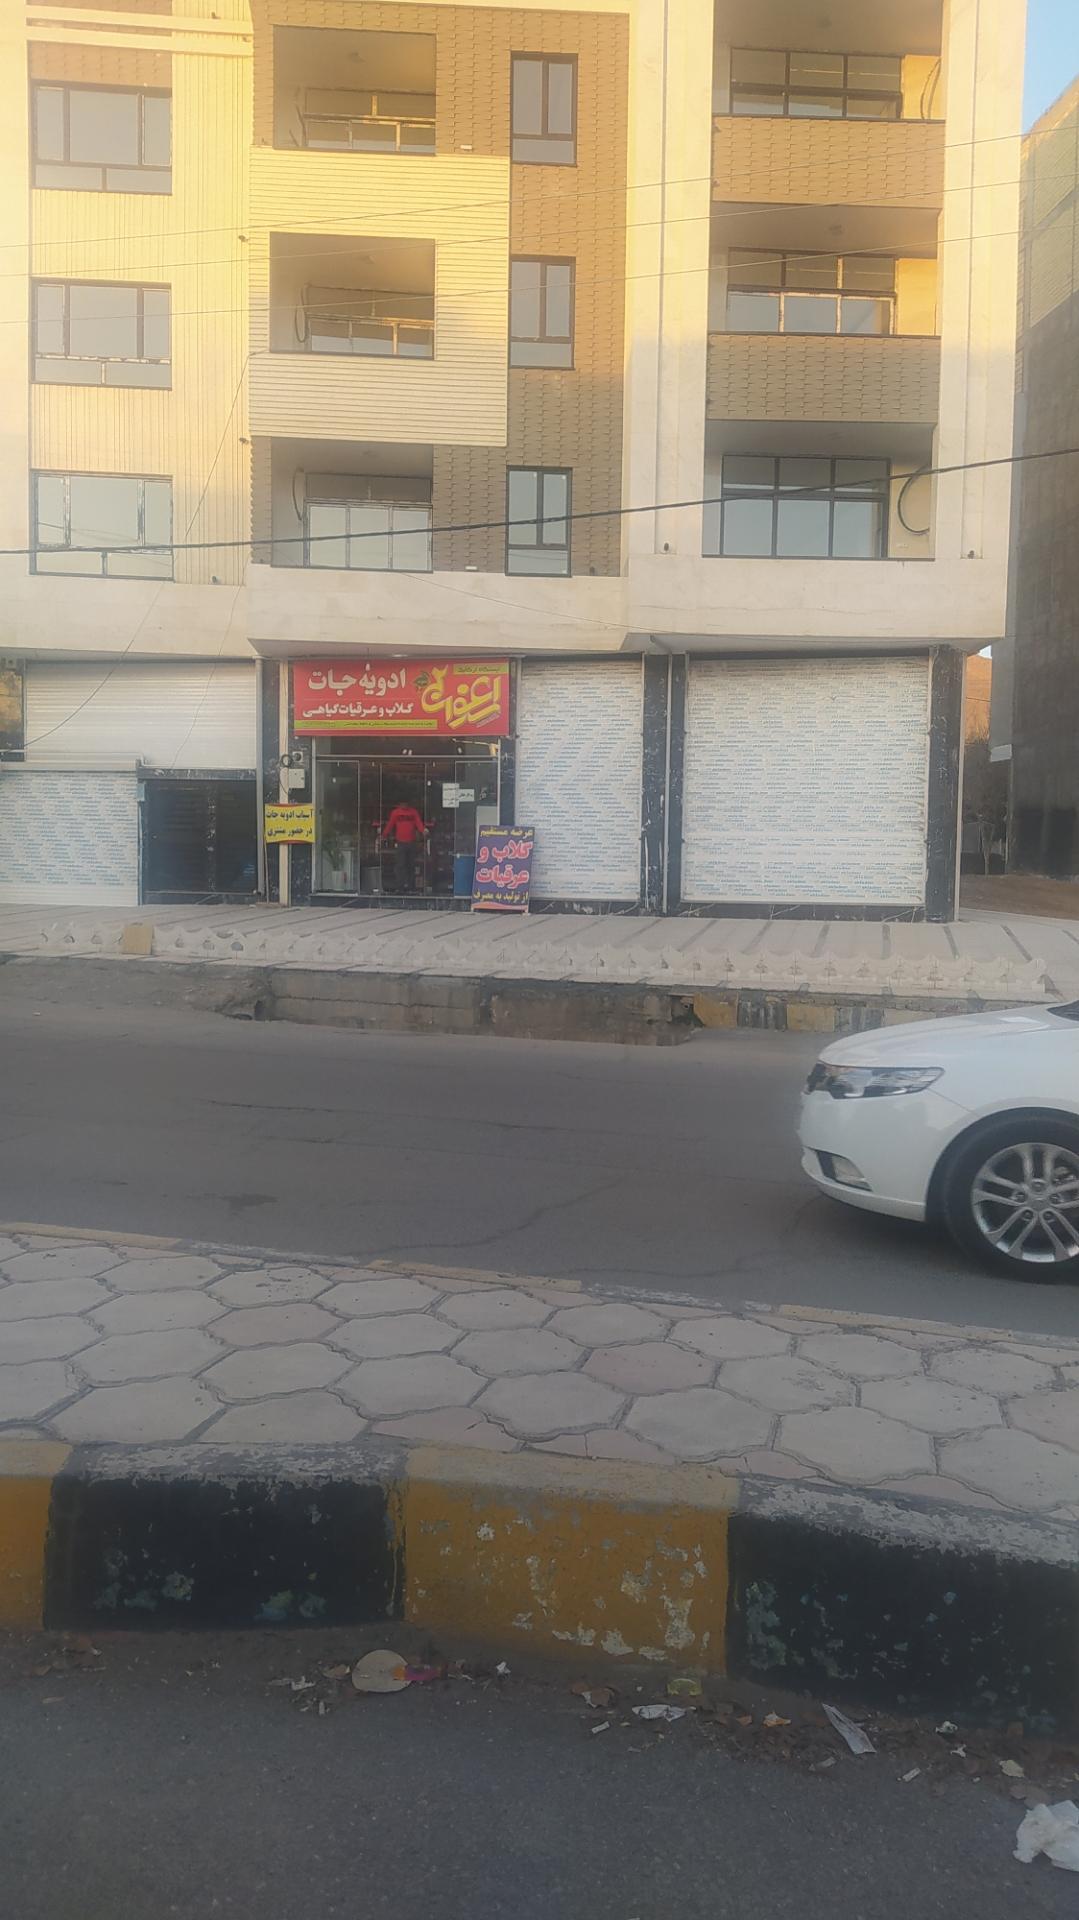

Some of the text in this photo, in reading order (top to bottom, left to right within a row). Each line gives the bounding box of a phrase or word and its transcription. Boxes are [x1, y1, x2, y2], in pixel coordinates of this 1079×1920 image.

[308, 668, 358, 696] جات
[302, 701, 415, 718] گلاب و عرقیات گیاهی
[267, 826, 313, 838] در حضور مشتری
[480, 826, 533, 839] عرضه مستقیم
[476, 846, 490, 863] و
[476, 864, 529, 889] عرقیات
[473, 889, 529, 904] از تولید به مصرف
